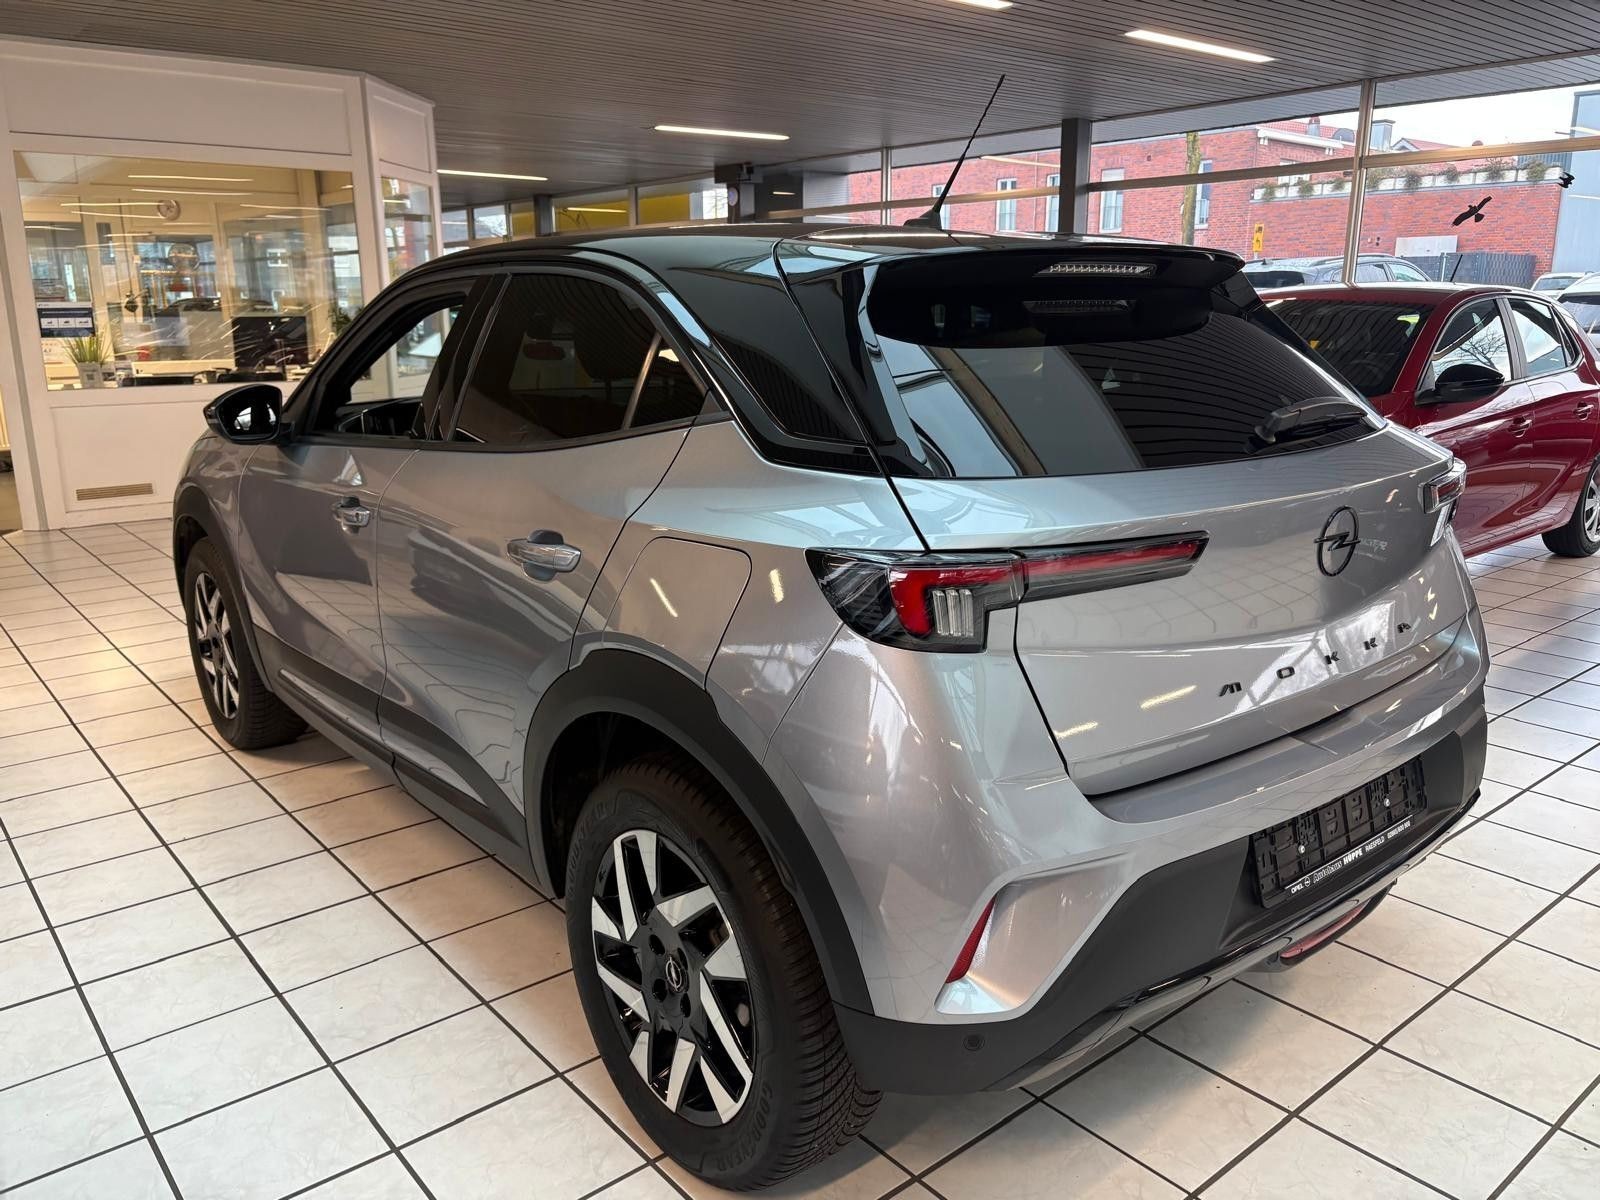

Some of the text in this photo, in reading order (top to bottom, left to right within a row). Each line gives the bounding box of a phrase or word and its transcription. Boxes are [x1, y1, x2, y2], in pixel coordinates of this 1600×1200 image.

[1219, 622, 1412, 698] MOKKA
[1291, 883, 1304, 894] OPEL
[1313, 860, 1343, 884] Autohaus
